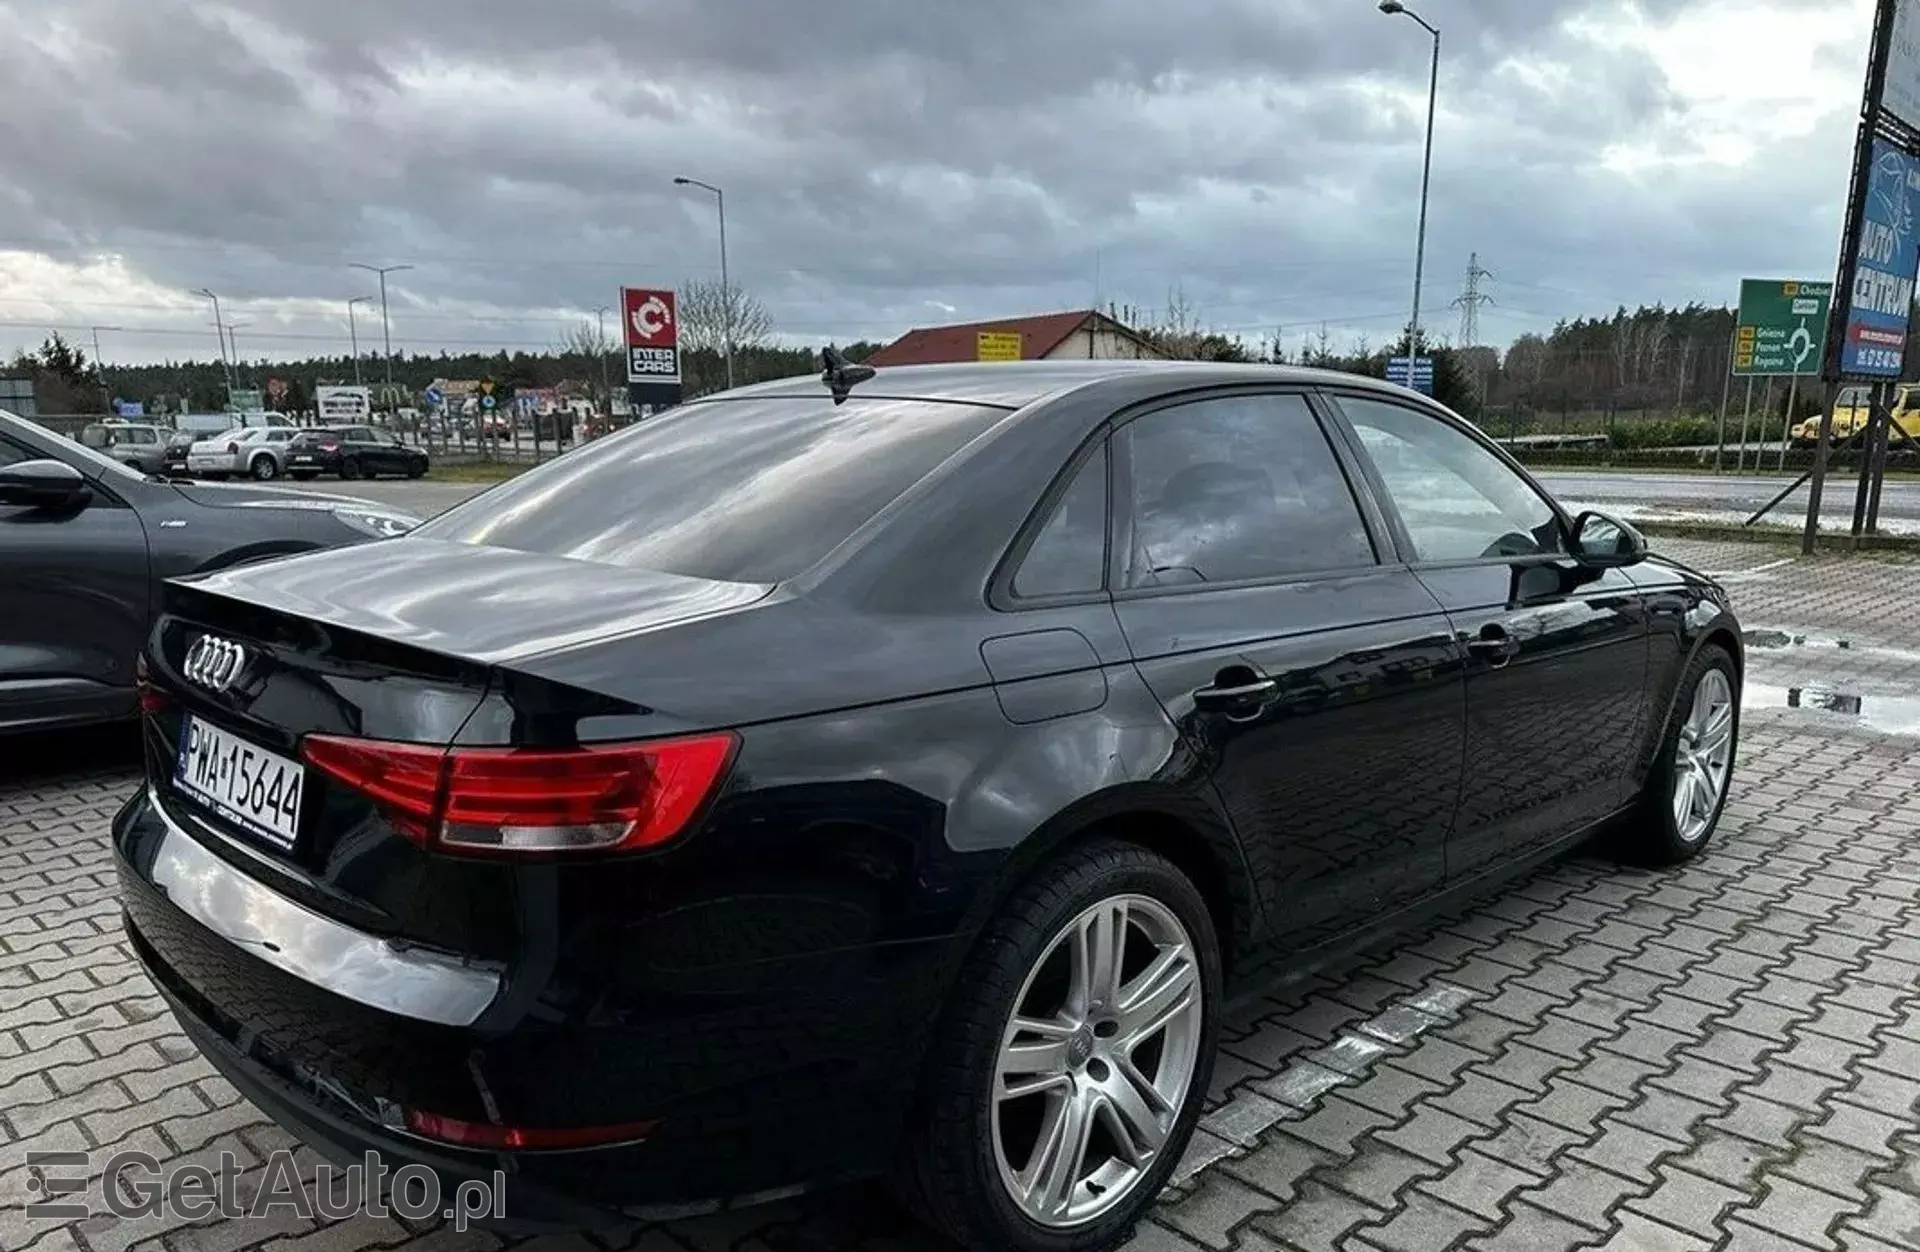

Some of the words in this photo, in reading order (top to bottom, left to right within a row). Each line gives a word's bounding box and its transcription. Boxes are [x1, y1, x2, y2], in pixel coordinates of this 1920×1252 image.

[1858, 219, 1894, 265] AUTO
[1851, 265, 1914, 318] CENTRUM
[632, 347, 674, 361] INTER
[633, 360, 676, 373] CARS
[227, 744, 301, 834] 15644
